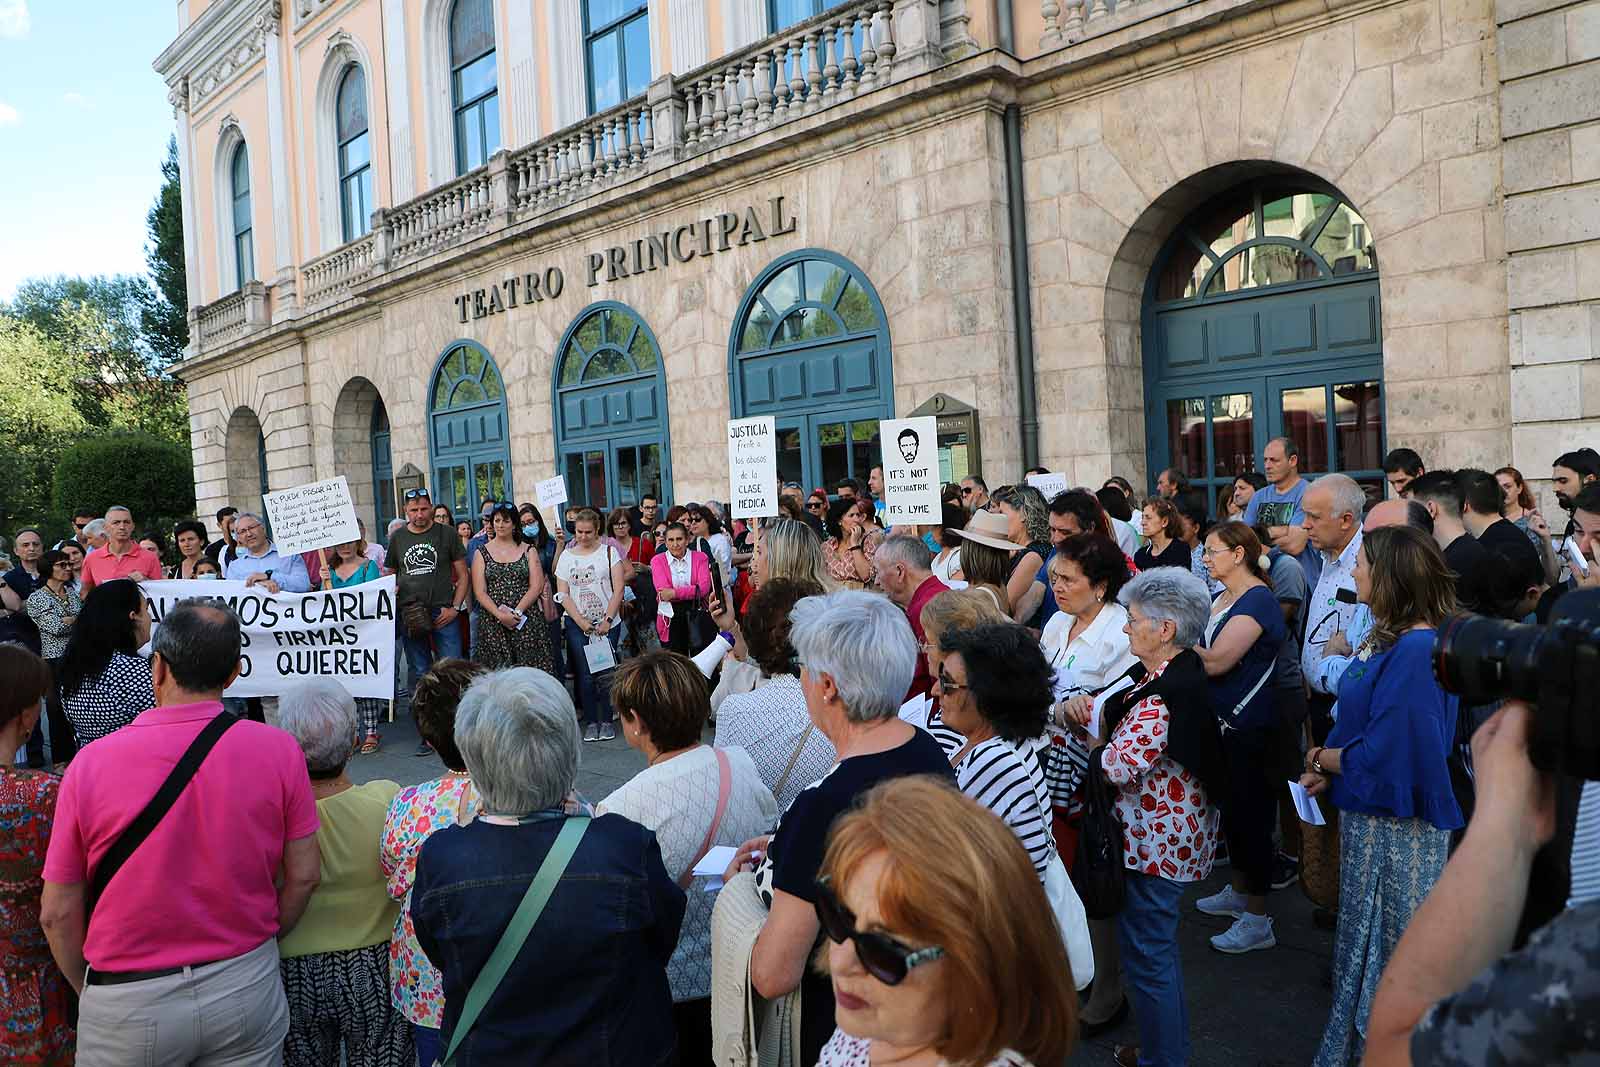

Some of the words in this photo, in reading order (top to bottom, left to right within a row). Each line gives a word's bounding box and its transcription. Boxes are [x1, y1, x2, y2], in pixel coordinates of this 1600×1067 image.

[454, 266, 564, 324] TEATRO
[584, 196, 796, 288] PRINCIPAL
[730, 423, 768, 438] JUSTICIA
[737, 439, 755, 453] frente
[735, 456, 745, 465] los
[746, 455, 767, 465] abusos
[740, 469, 748, 480] de
[751, 469, 758, 480] la
[889, 469, 905, 479] IT'S
[910, 468, 929, 479] NOT
[280, 493, 300, 503] PUEDE
[302, 487, 325, 497] PASAR
[738, 483, 762, 494] CLASE
[888, 483, 929, 493] PSYCHIATRIC
[908, 504, 930, 514] LYME
[146, 595, 279, 628] ALMOS
[283, 607, 295, 619] a
[301, 588, 394, 624] CARLA
[273, 625, 358, 646] FIRMAS
[276, 648, 379, 676] QUIEREN
